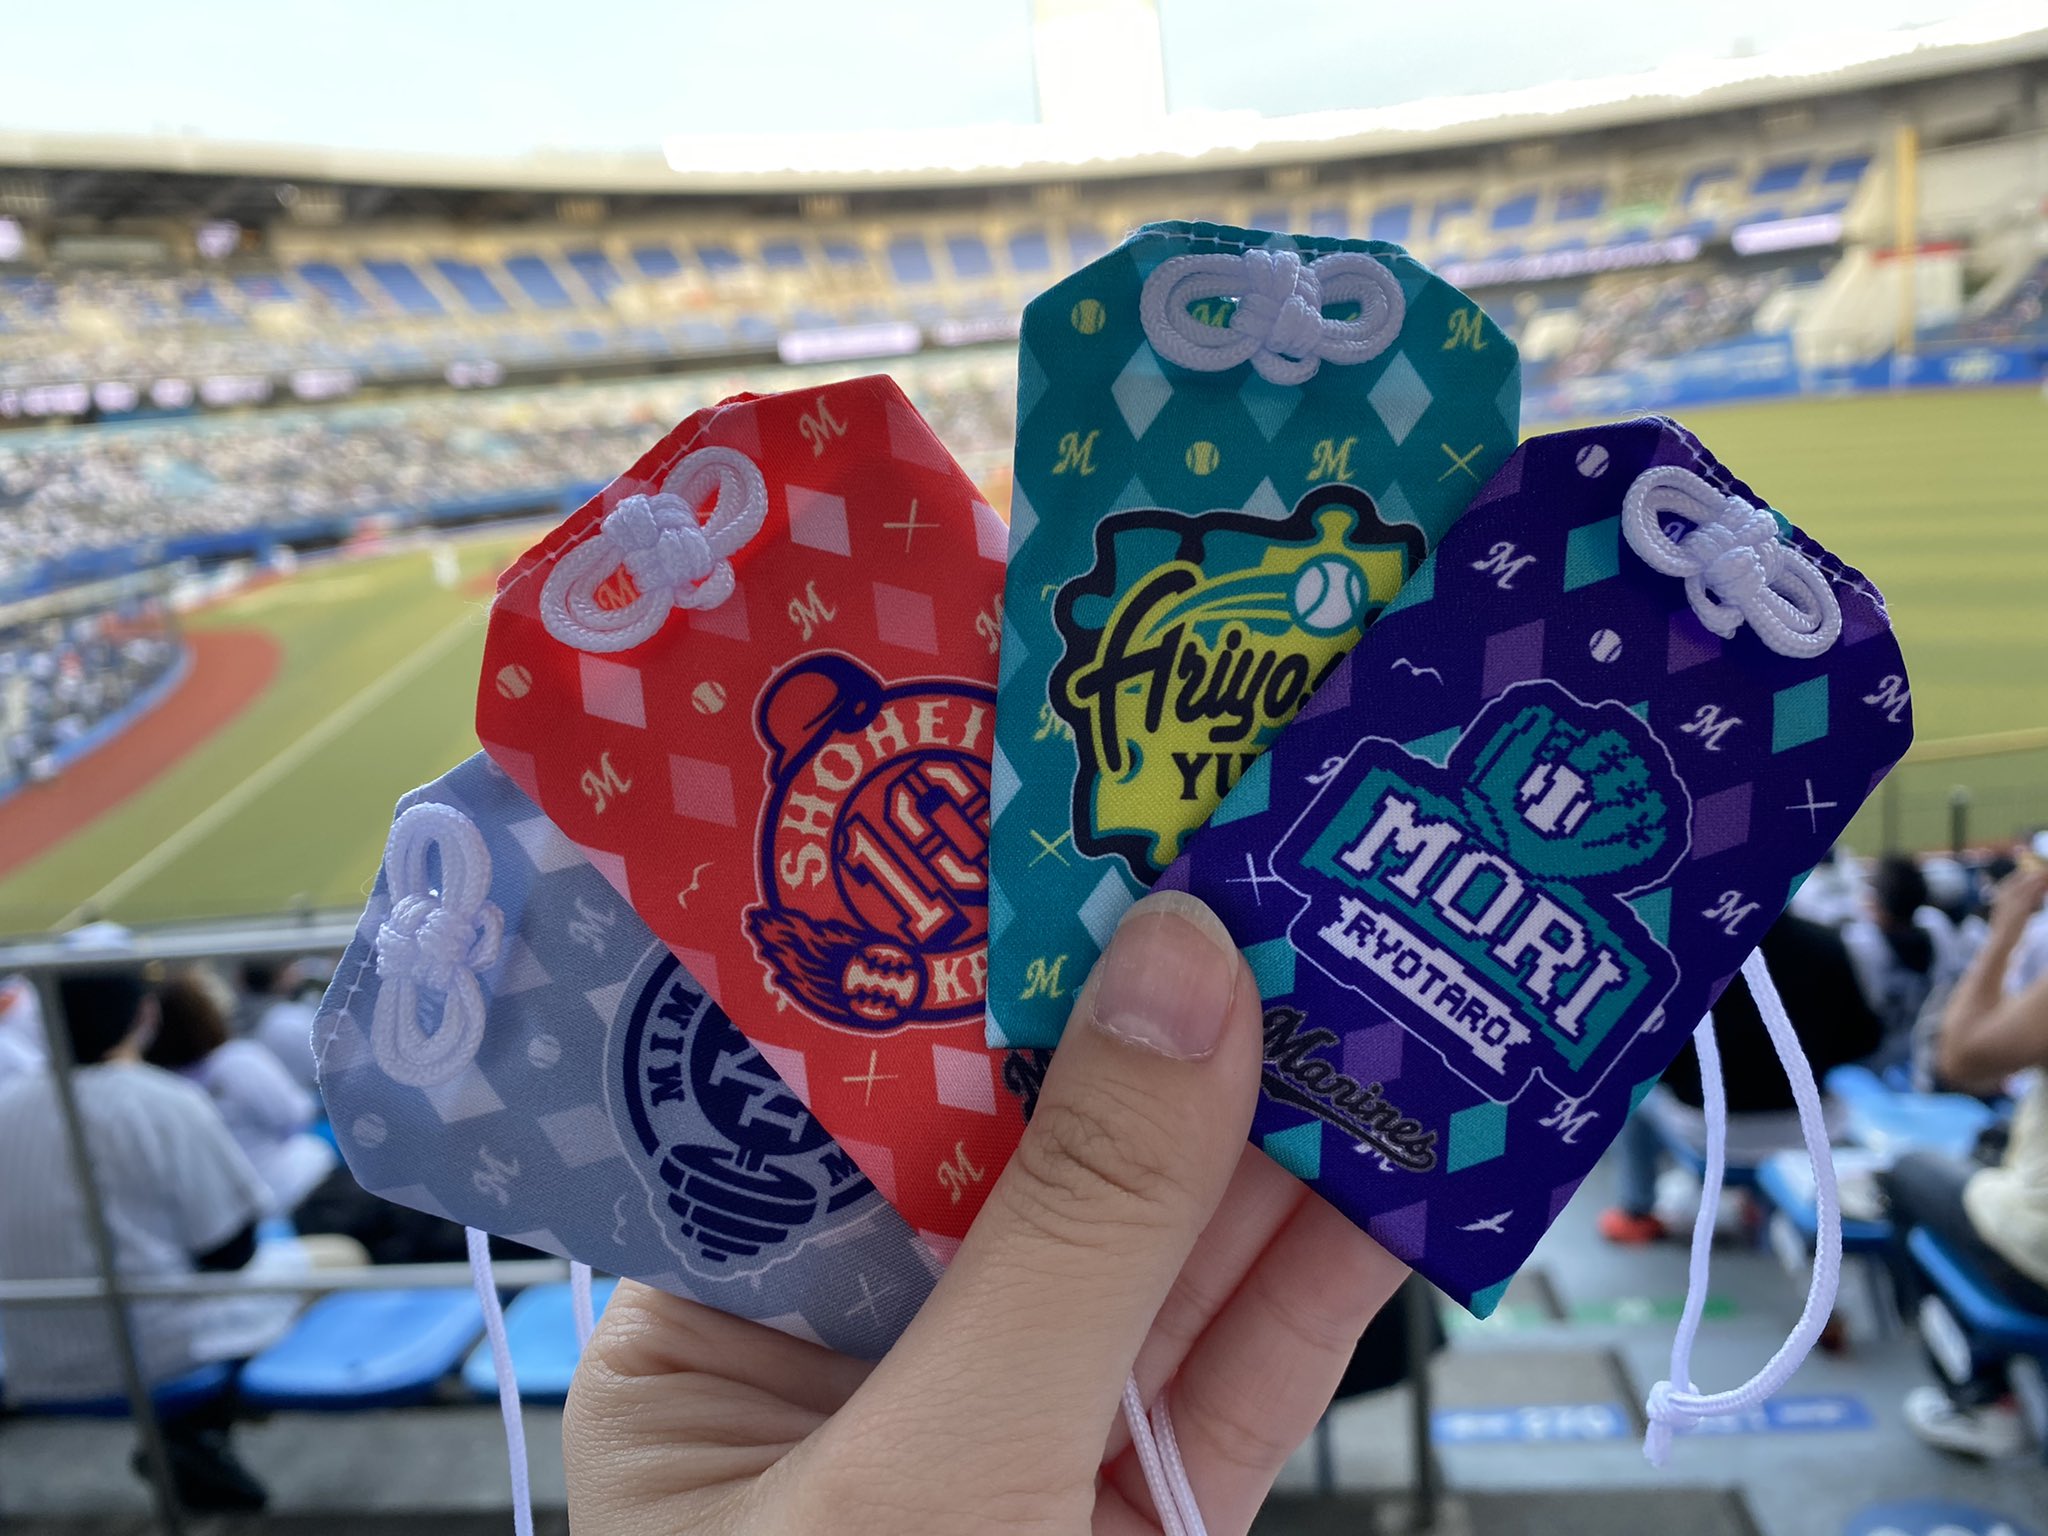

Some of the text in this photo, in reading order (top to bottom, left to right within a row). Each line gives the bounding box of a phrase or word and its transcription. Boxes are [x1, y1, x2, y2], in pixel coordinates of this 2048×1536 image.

[1440, 307, 1488, 352] M
[800, 395, 848, 459] M
[1052, 430, 1100, 478] M
[1307, 436, 1359, 482] M
[1472, 541, 1537, 590] M
[788, 580, 837, 642] M
[1862, 674, 1911, 723] M
[1680, 704, 1743, 752] M
[581, 751, 633, 814] M
[780, 699, 987, 891] SHOHEI
[1341, 795, 1624, 1038] MORI
[1702, 890, 1760, 936] M
[1020, 954, 1069, 1001] M
[1343, 910, 1514, 1048] RYOTARO
[1262, 1004, 1439, 1160] Marines
[1538, 1098, 1600, 1145] M
[937, 1140, 985, 1205] M
